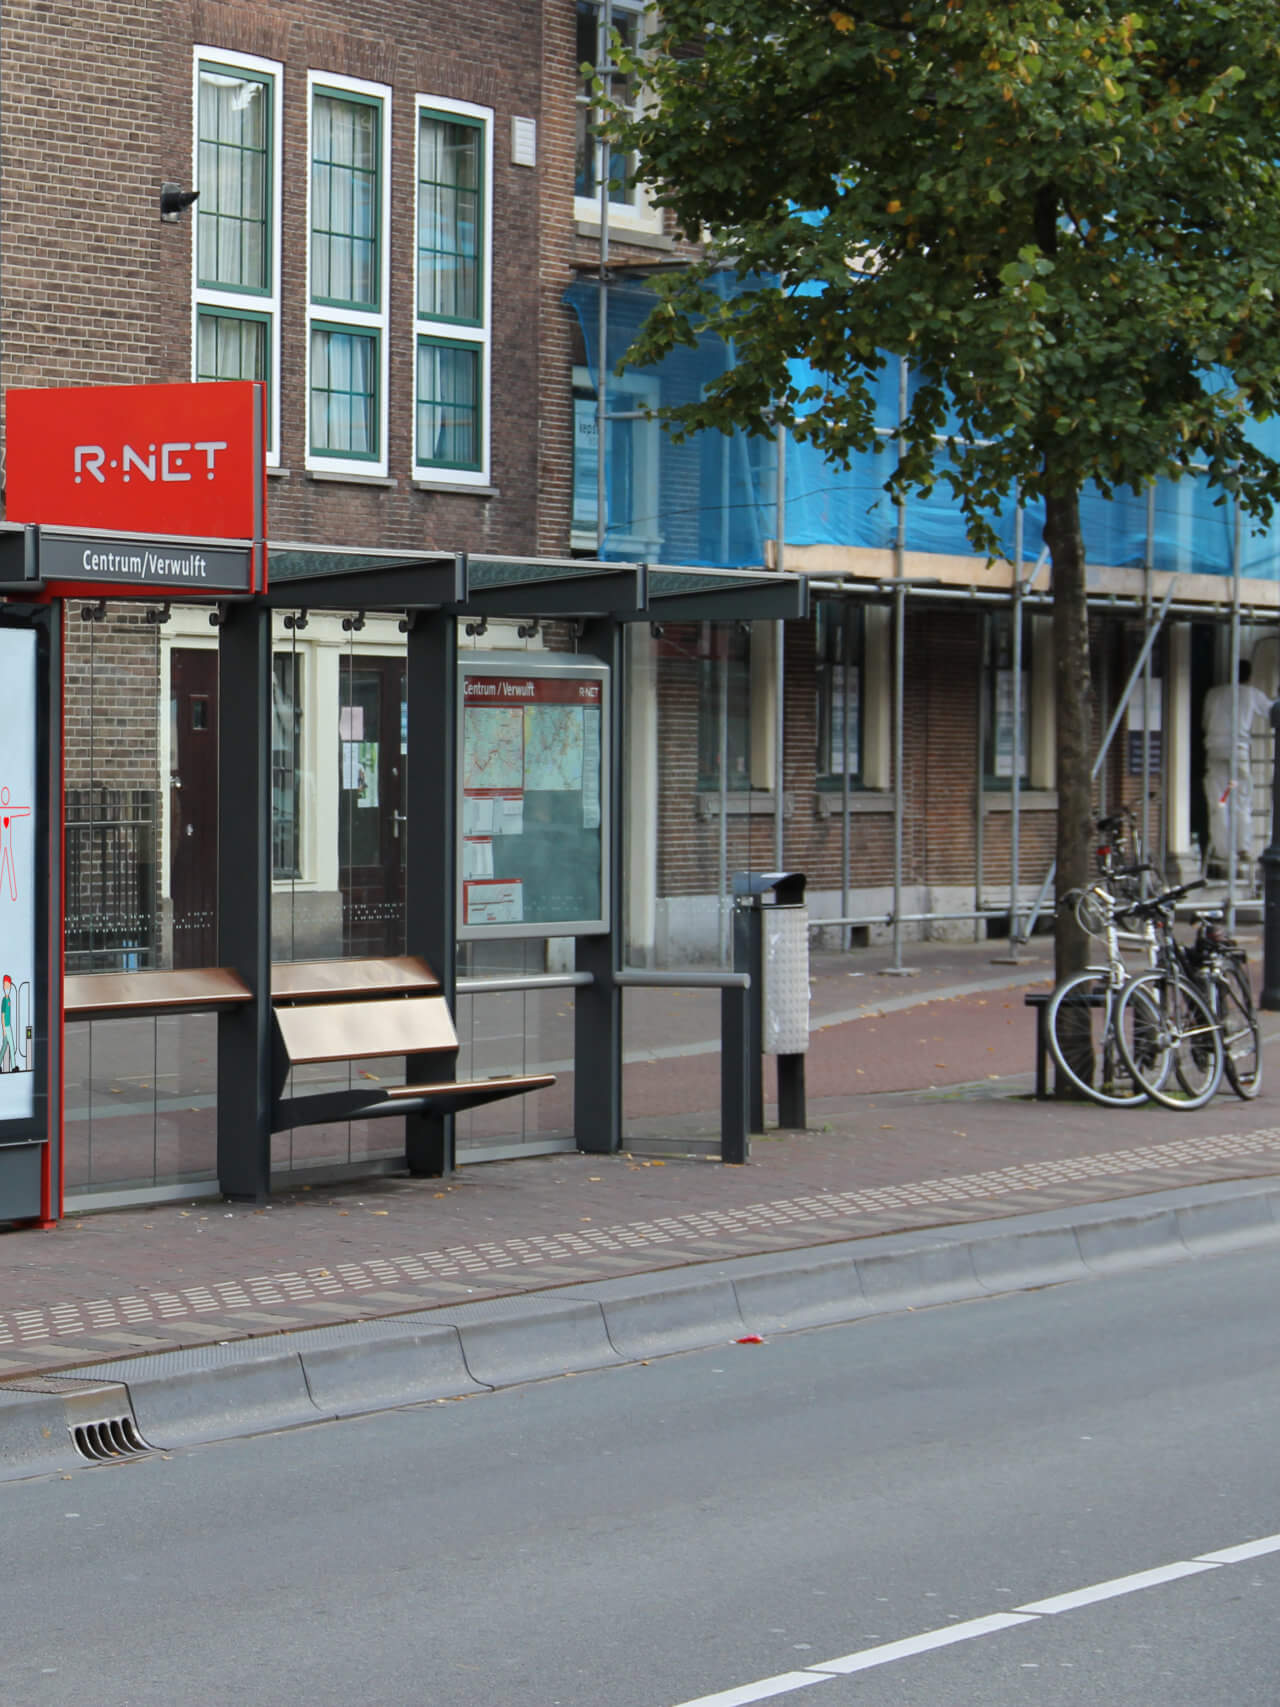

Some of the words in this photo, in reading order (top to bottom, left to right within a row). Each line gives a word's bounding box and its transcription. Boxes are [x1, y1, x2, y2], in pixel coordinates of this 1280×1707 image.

[82, 549, 207, 579] Centrum/Verwulft
[463, 681, 496, 696] Centrum
[502, 681, 535, 697] Verwulft
